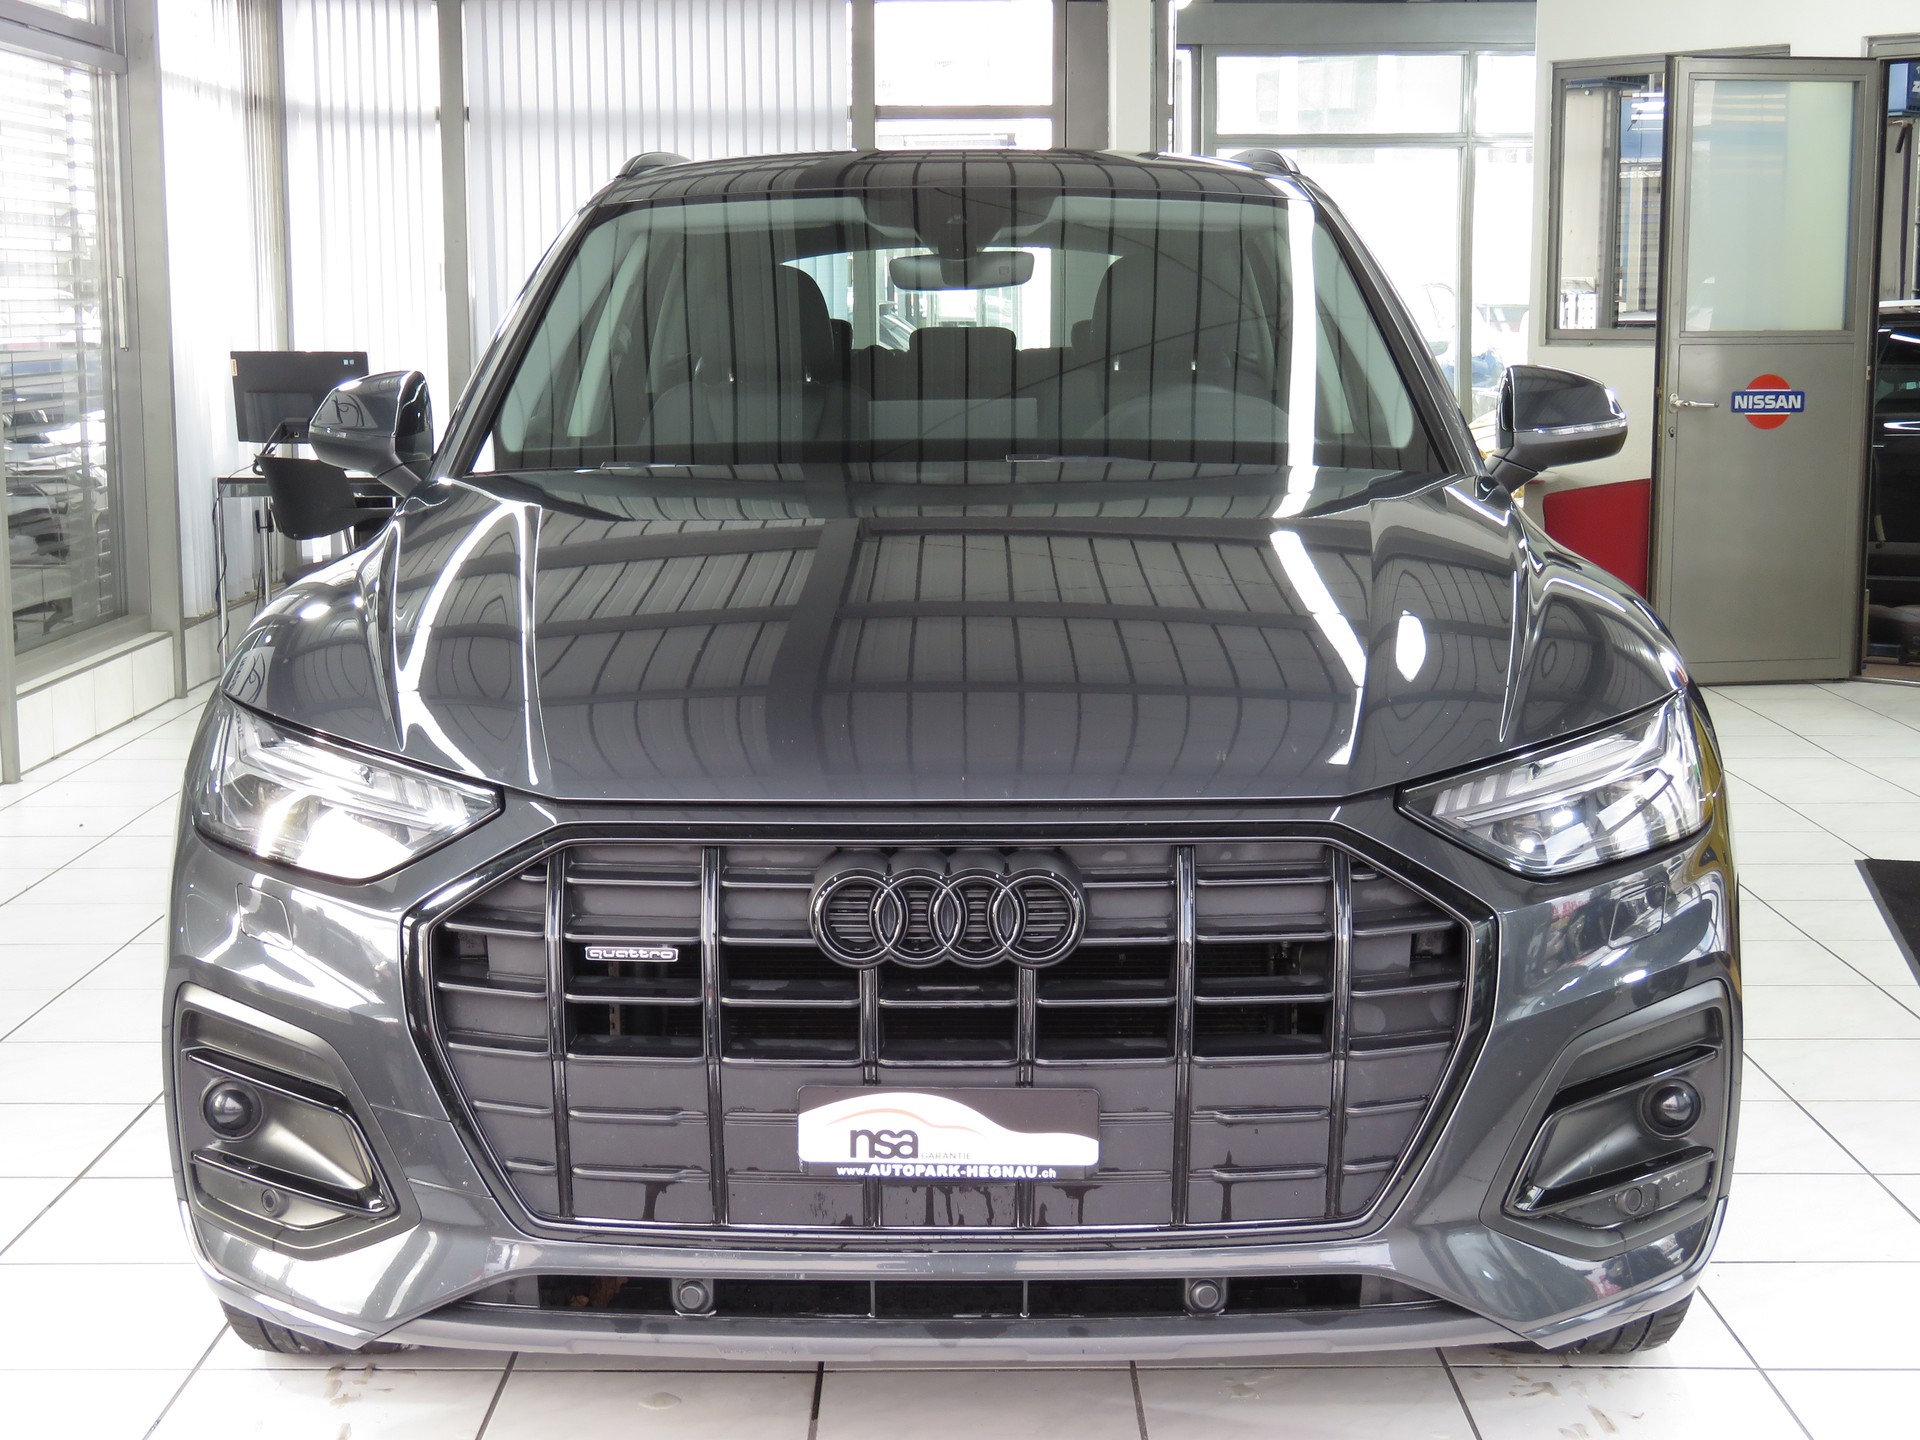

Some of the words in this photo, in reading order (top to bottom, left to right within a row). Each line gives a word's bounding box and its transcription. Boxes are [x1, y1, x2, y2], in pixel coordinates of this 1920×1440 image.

[1734, 395, 1801, 409] NISSAN
[588, 949, 674, 959] quattro
[850, 1129, 919, 1159] nsa
[921, 1152, 971, 1160] GARANTIE
[836, 1163, 1057, 1178] www.AUTOPARK-HEGNAU.ch
